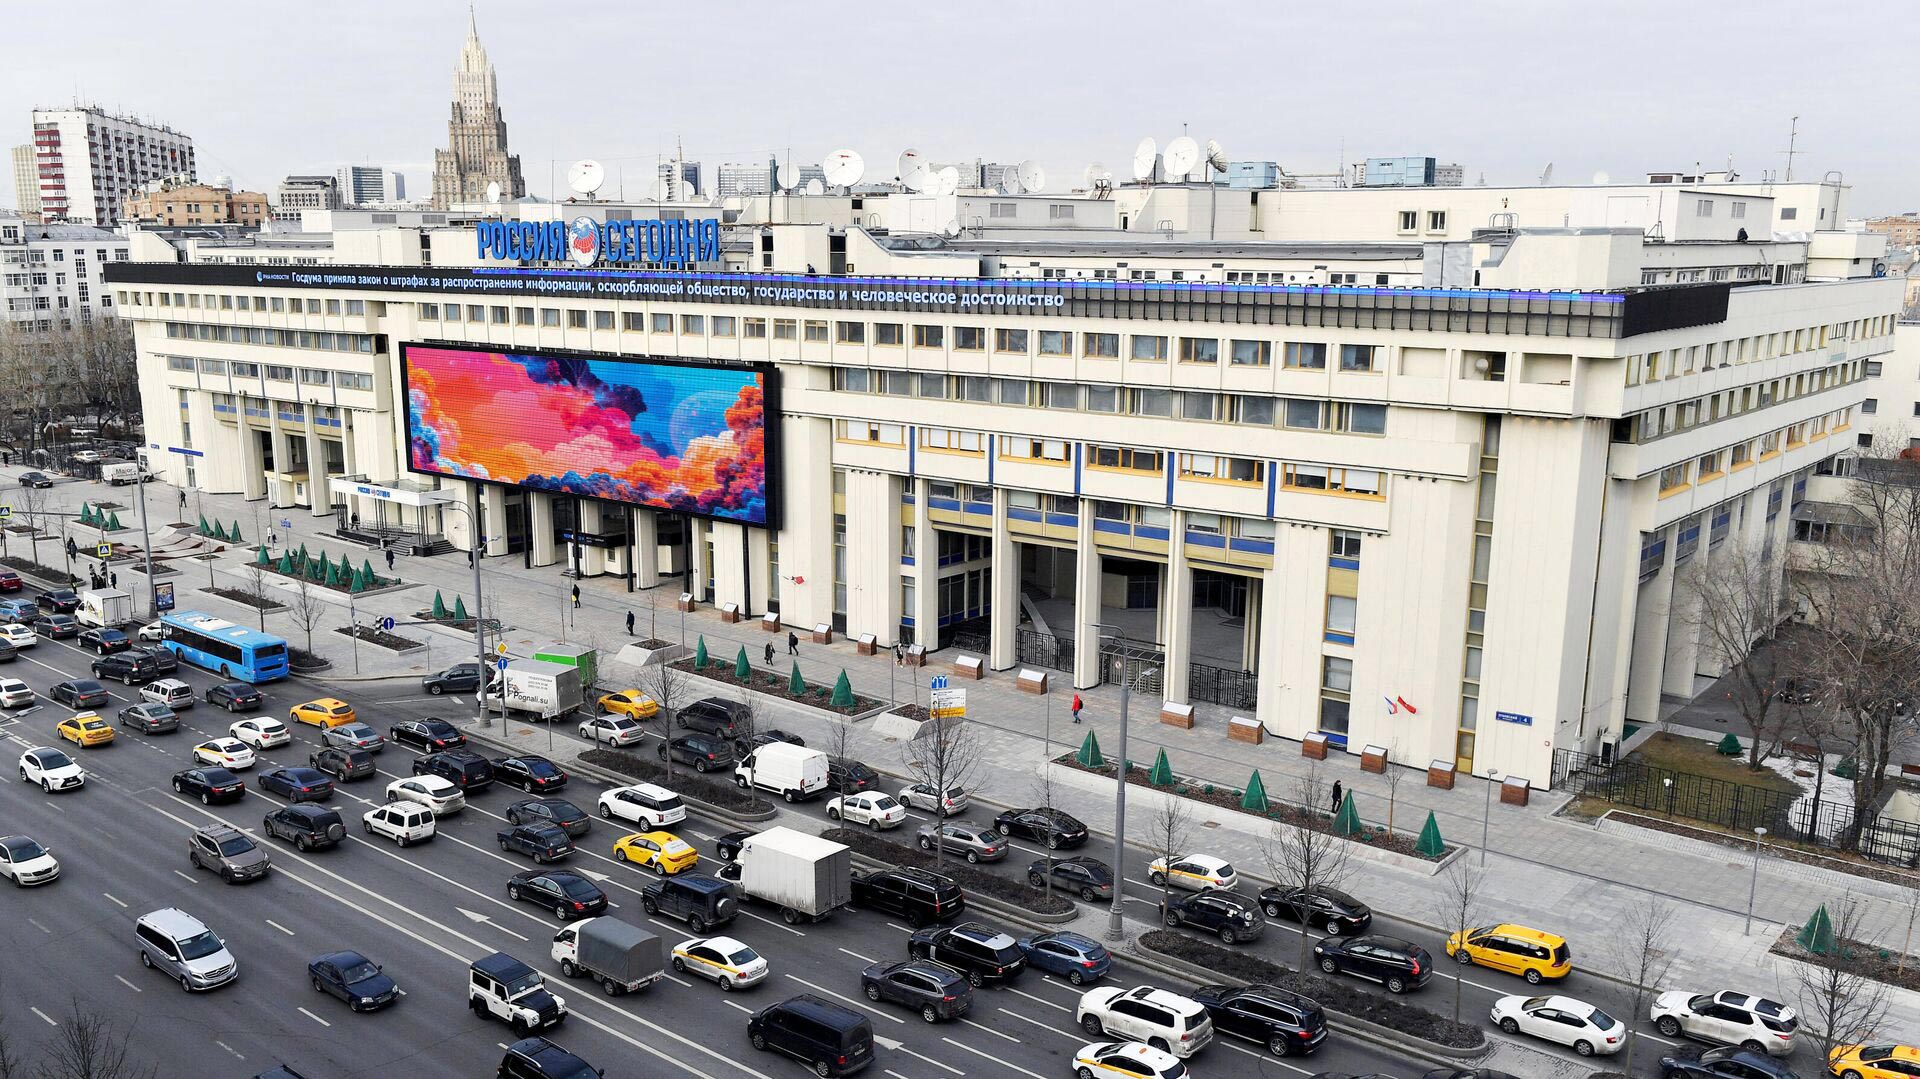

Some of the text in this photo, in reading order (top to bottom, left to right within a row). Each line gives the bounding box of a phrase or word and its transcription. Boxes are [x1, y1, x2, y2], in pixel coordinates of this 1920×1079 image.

[476, 218, 720, 269] РОССИЯ СЕГОДНЯ
[291, 272, 1065, 307] Госдума приняла закон о штрафах за распространение информации, оскорбляющей общество, государство и человеческое достоинство
[513, 690, 549, 705] Pognali.su
